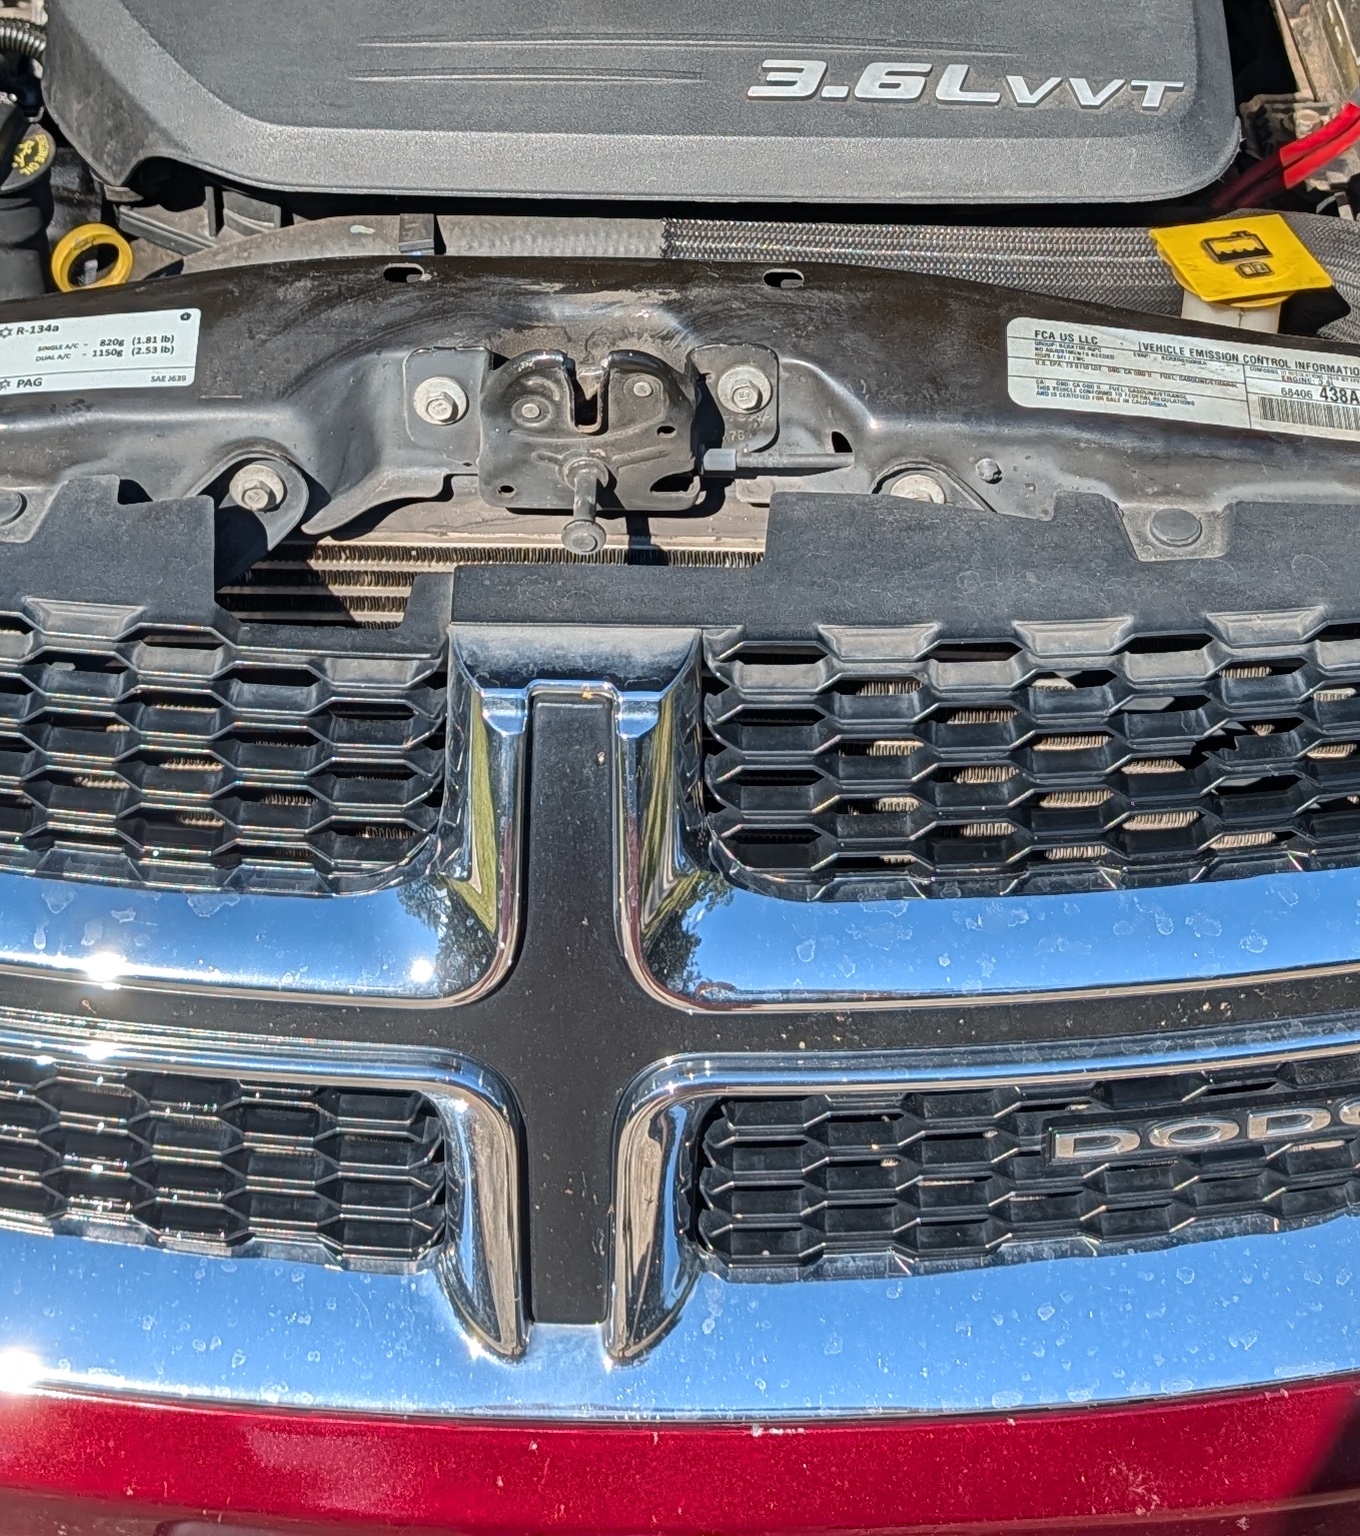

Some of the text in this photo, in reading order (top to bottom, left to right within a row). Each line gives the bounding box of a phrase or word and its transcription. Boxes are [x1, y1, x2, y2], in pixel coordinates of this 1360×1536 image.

[16, 324, 59, 336] R-134a
[100, 338, 125, 347] 820g
[132, 335, 158, 346] (1.81
[160, 334, 175, 344] lb)
[1034, 330, 1098, 345] FCA US LLC
[36, 354, 56, 362] DUAL
[92, 348, 124, 358] 1150g
[131, 346, 158, 356] (2.53
[160, 345, 175, 355] lb)
[1142, 344, 1185, 356] VEHICLE
[1189, 348, 1239, 362] EMISSION
[1243, 354, 1291, 368] CONTROL
[17, 378, 43, 388] PAG
[151, 375, 167, 383] SAE
[1280, 387, 1313, 399] 68406
